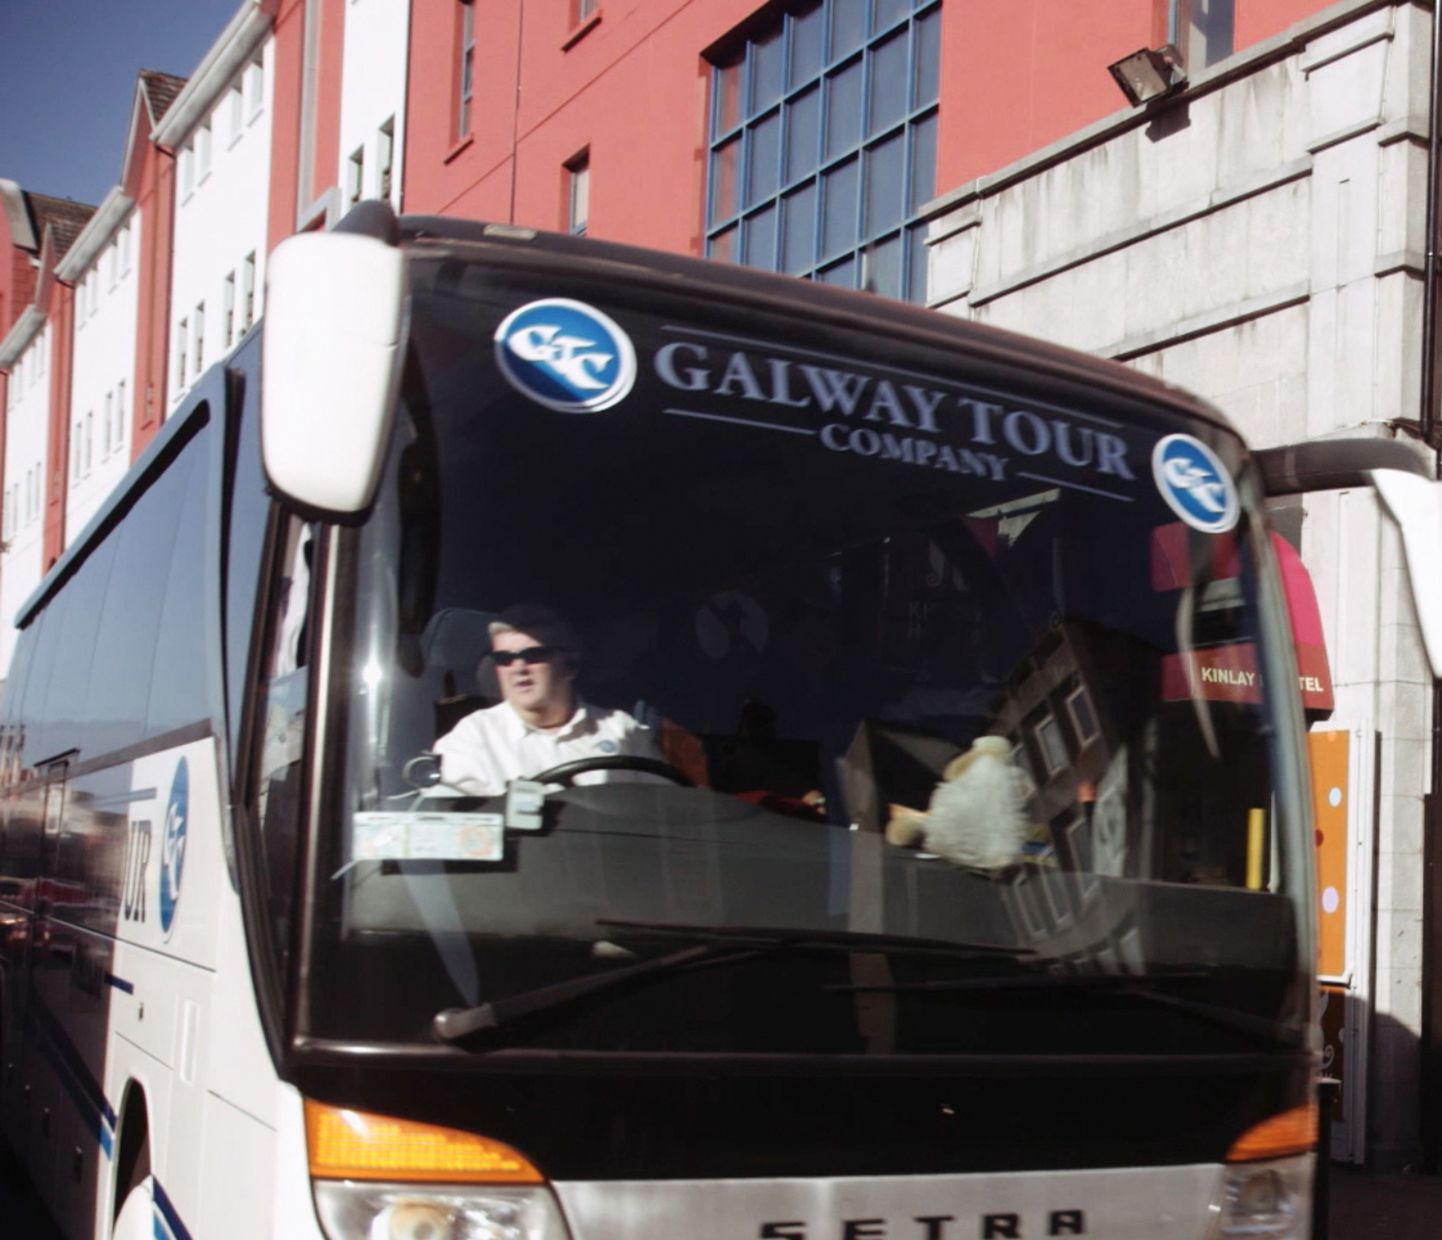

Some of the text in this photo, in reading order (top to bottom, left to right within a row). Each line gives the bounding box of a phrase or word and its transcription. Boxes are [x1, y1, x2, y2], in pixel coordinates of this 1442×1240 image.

[654, 340, 1137, 482] GALWAY TOUR
[819, 423, 1010, 482] COMPANY
[1201, 667, 1255, 687] KINLAY
[124, 820, 152, 924] UR
[760, 1209, 1086, 1240] SETRA
